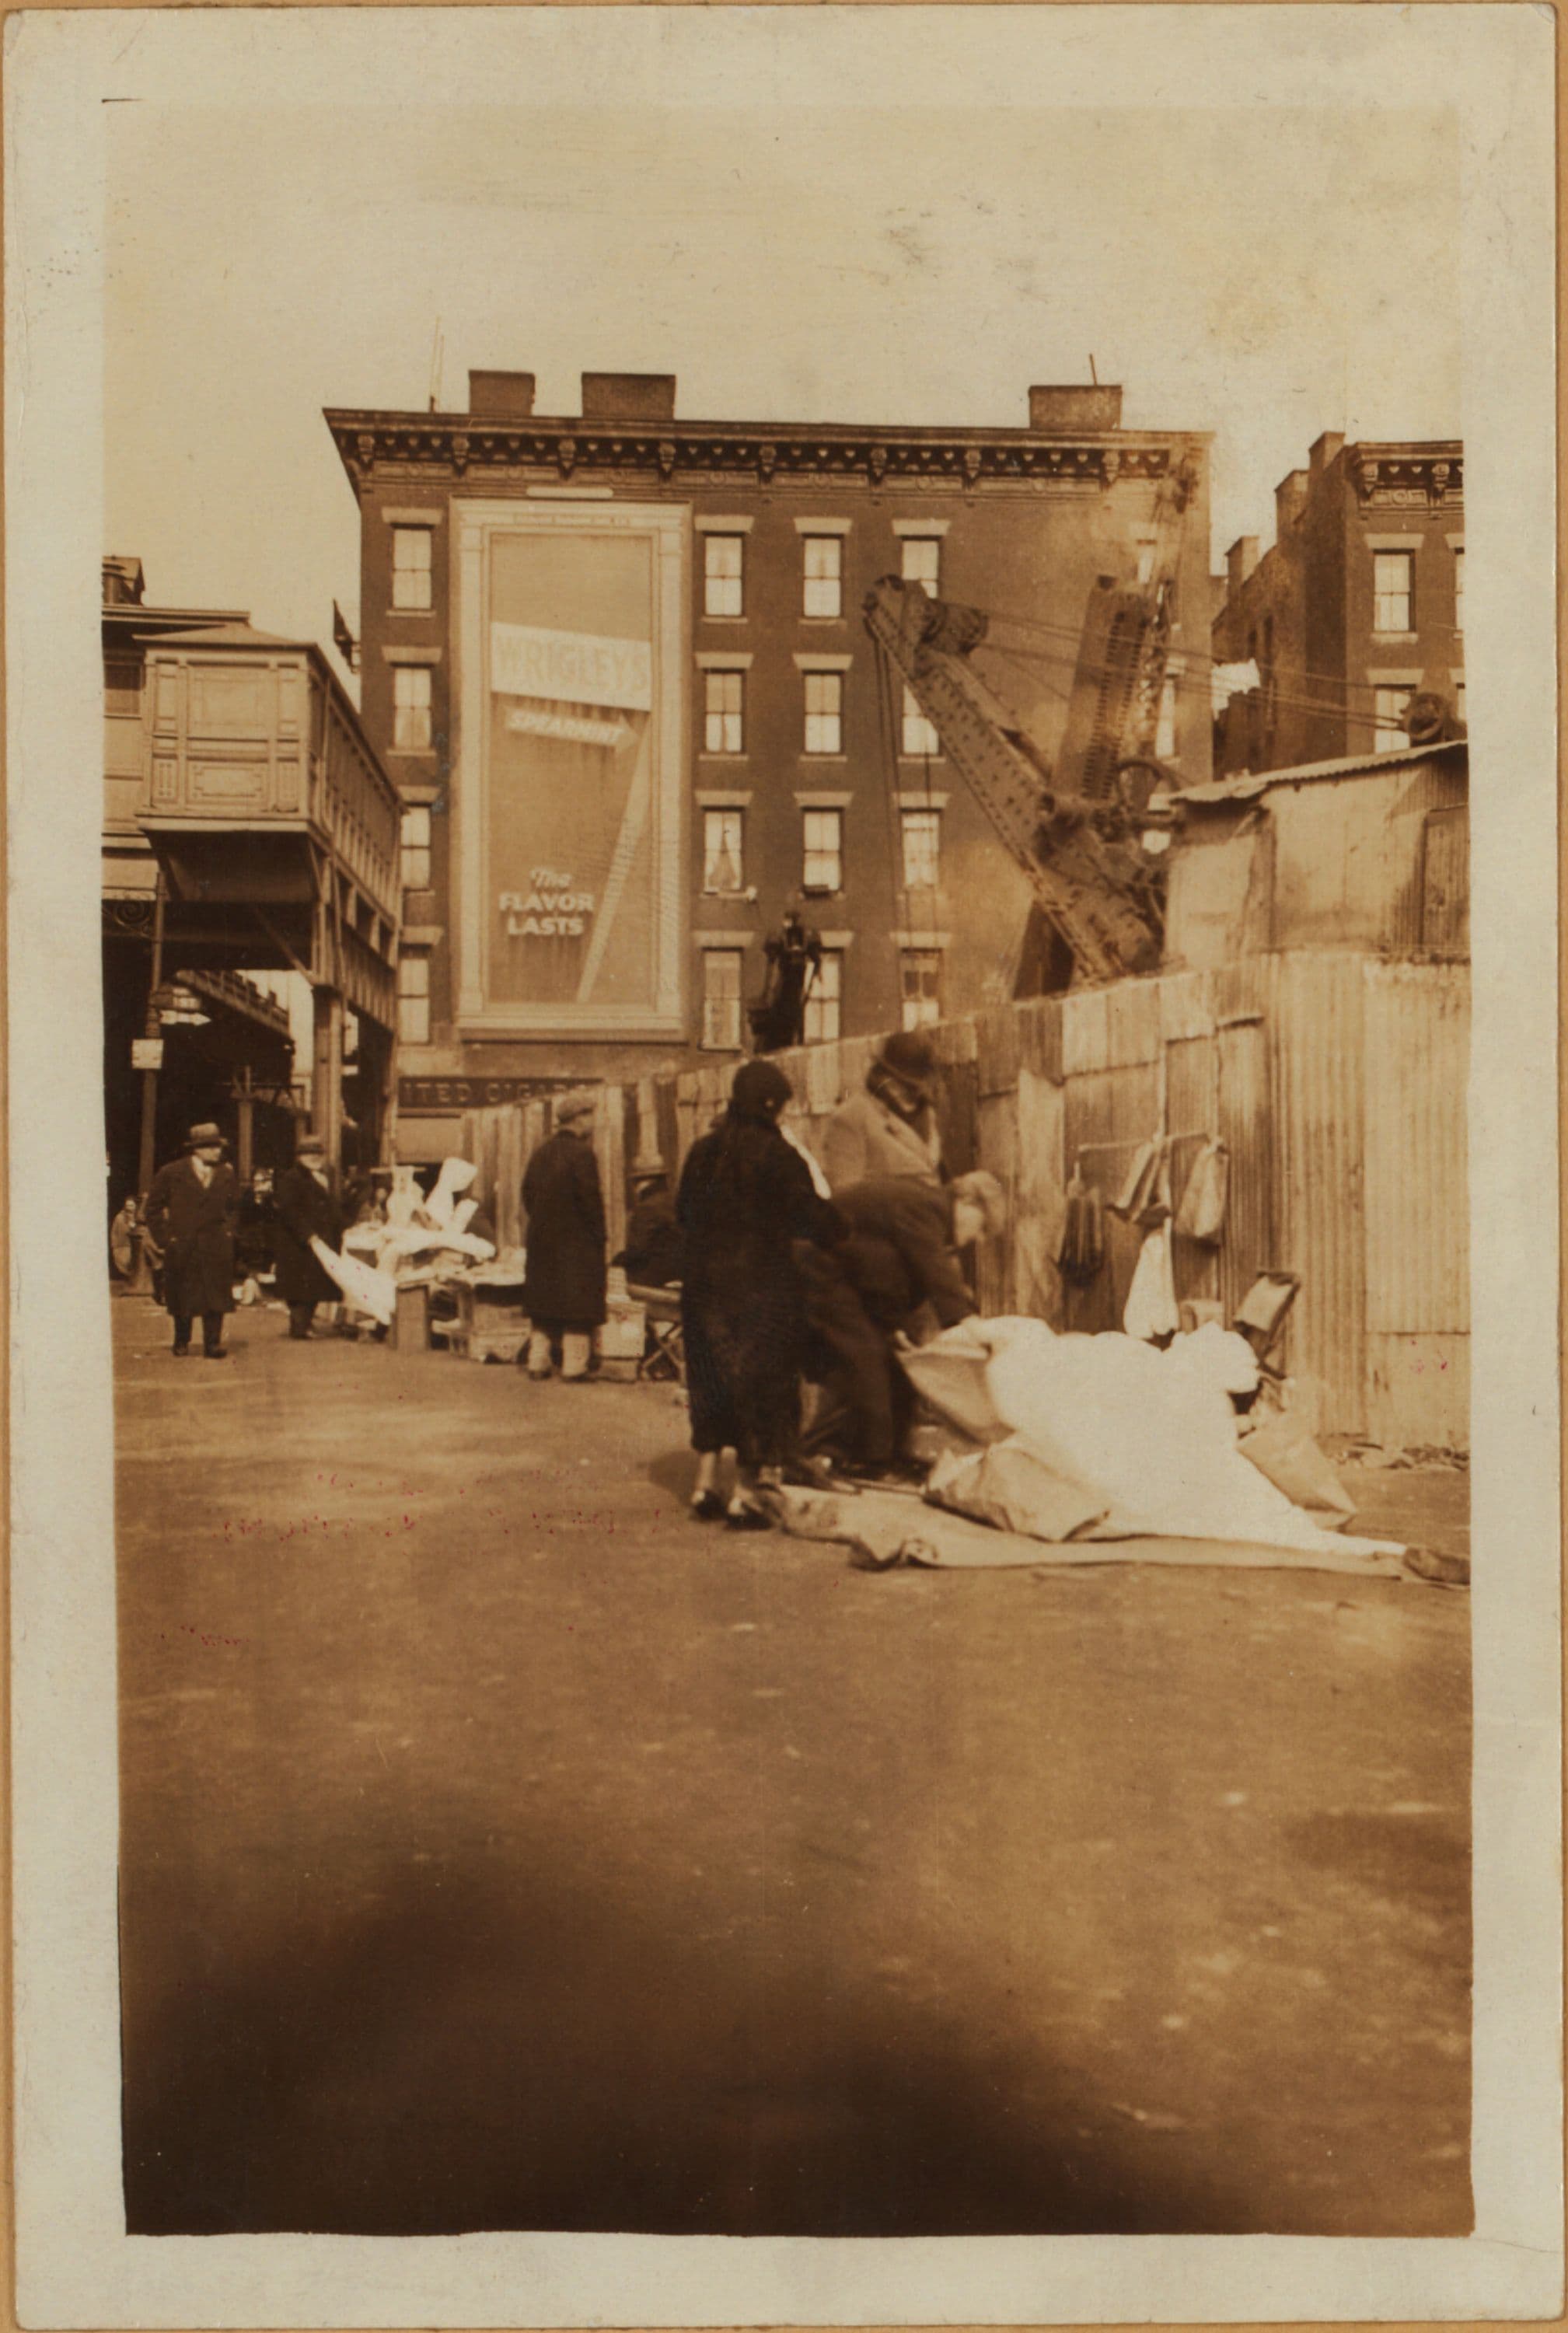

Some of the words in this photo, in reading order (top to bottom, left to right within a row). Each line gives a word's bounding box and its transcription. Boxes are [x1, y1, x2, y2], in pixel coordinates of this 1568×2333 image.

[530, 867, 572, 888] The
[499, 893, 594, 911] FLAVOR
[508, 916, 583, 936] LASTS
